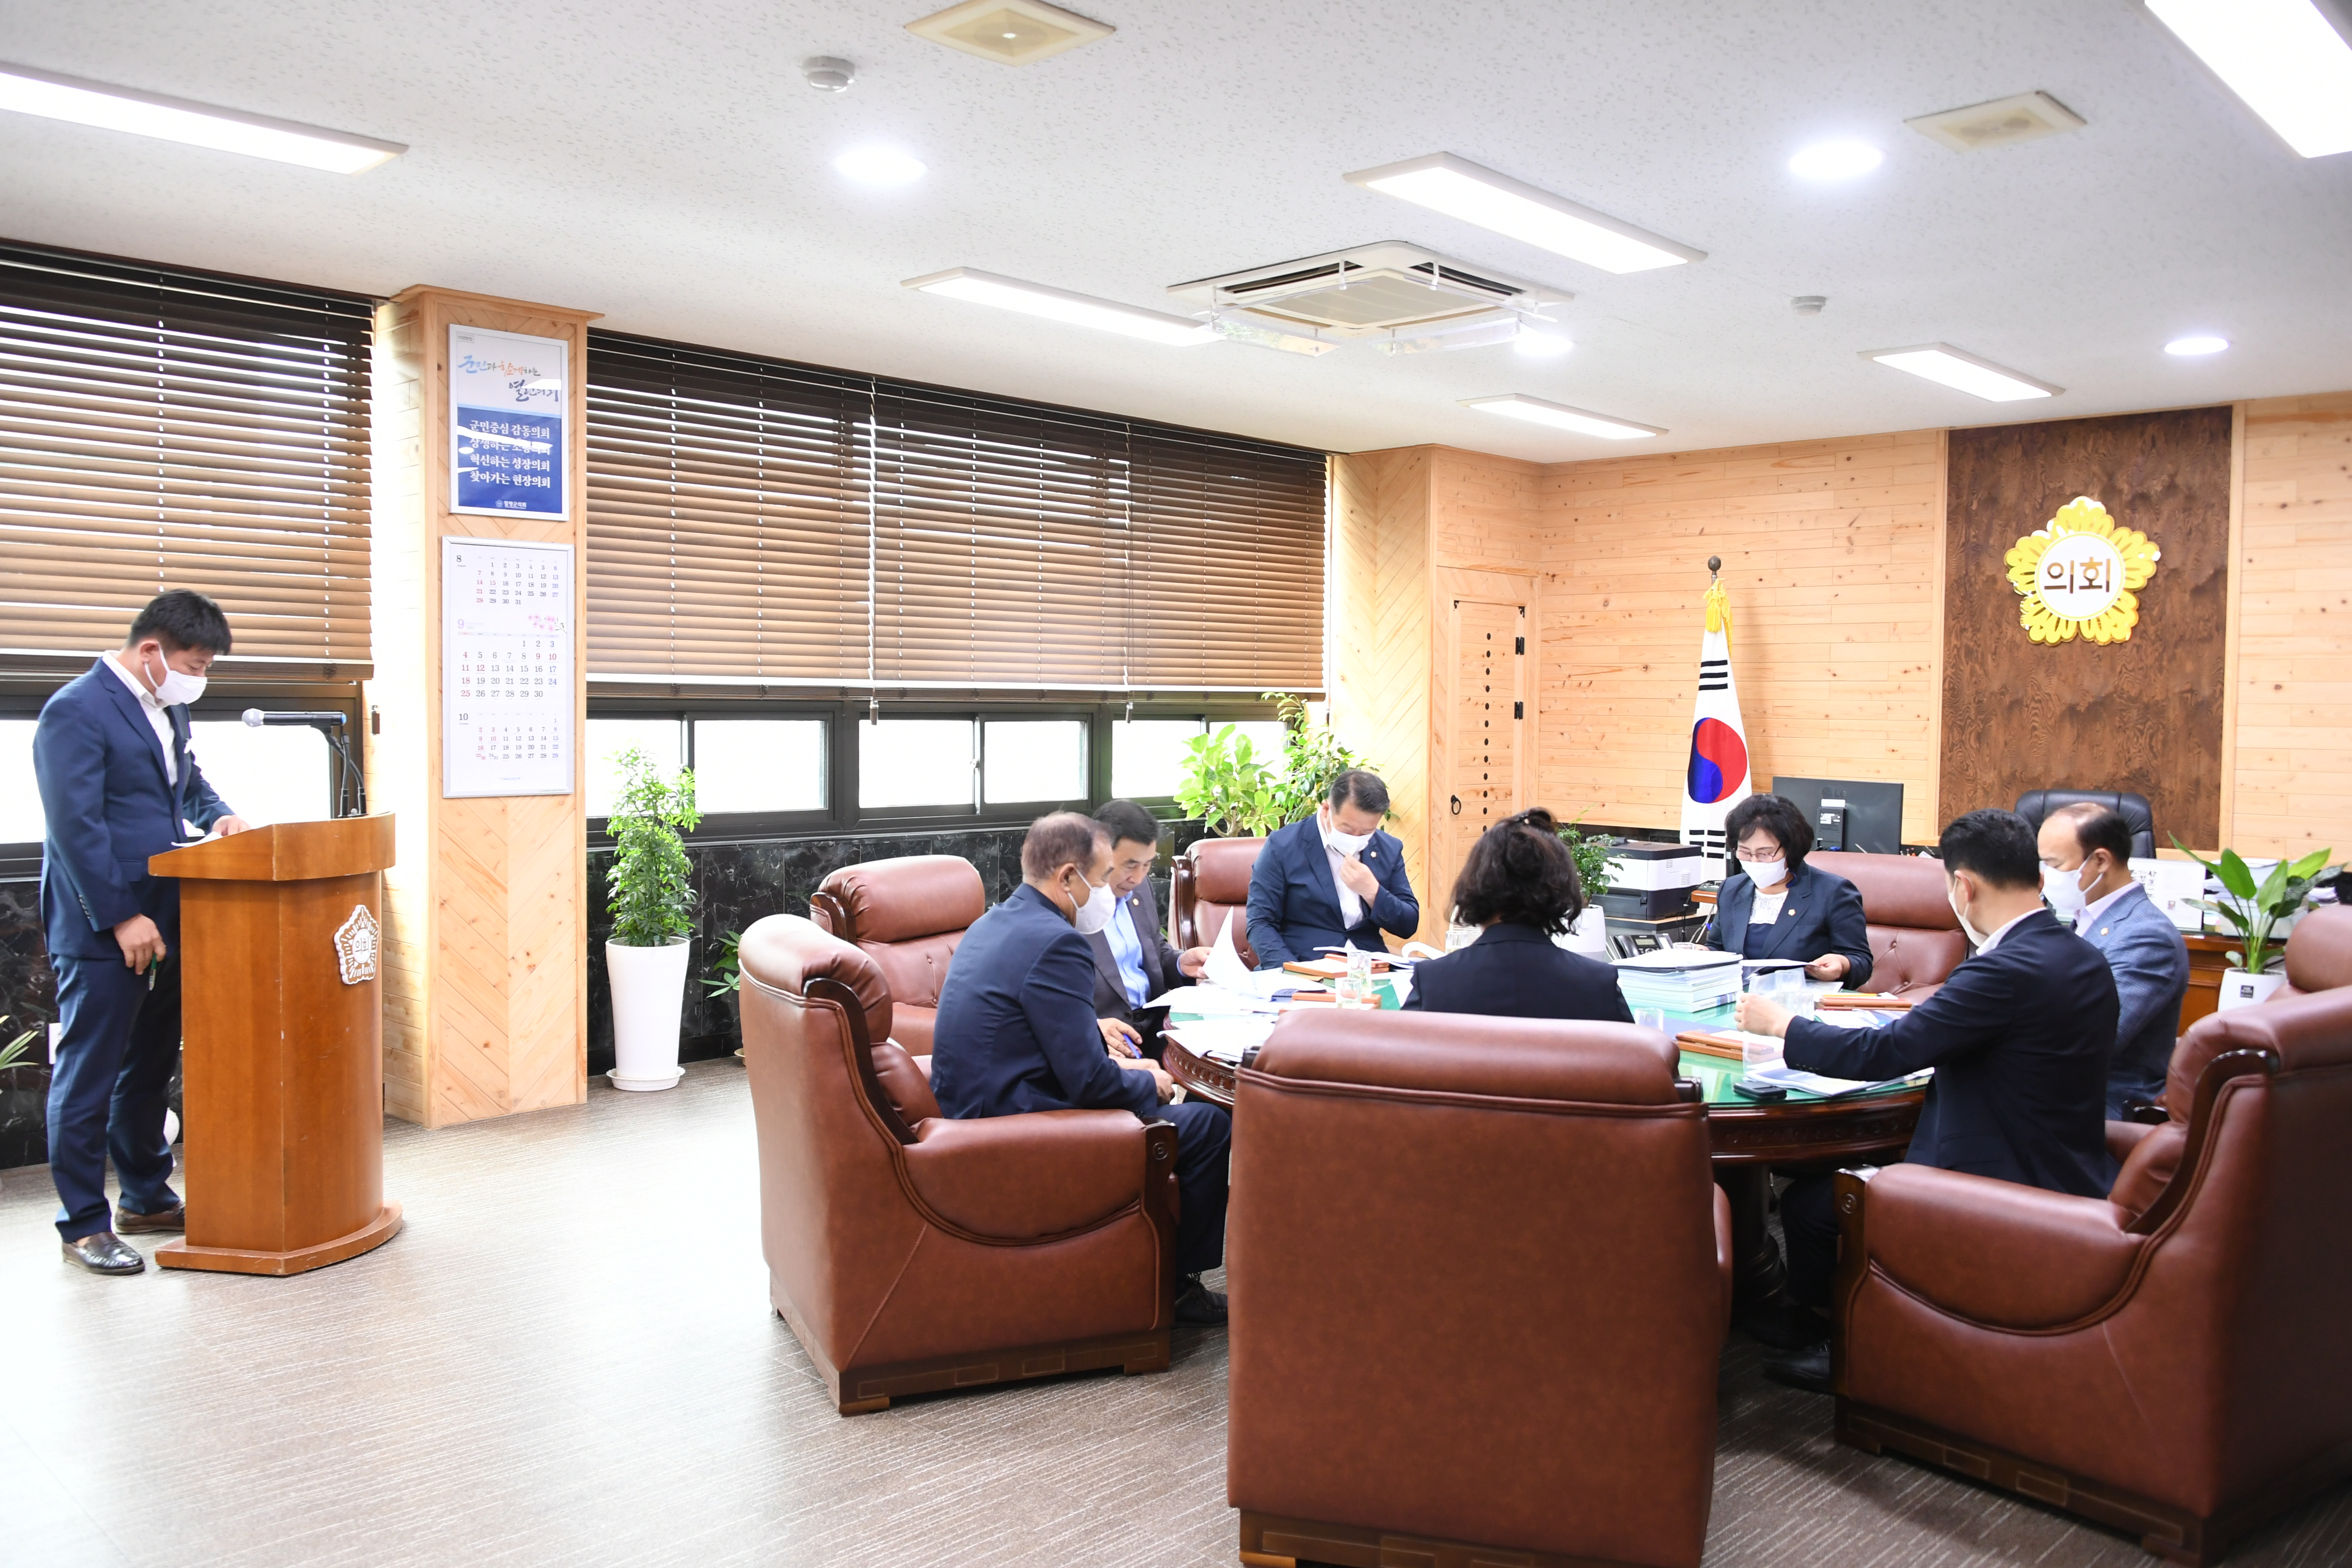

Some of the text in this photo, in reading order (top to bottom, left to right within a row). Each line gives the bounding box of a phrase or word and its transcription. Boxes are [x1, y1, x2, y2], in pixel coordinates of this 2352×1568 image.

[457, 355, 541, 377] 군민과 함께하는
[469, 420, 550, 438] 군민중심 감동의회
[470, 453, 550, 472] 혁신하는 성장의회
[470, 471, 550, 488] 찾아가는 현장의회
[2044, 556, 2111, 594] 의회
[457, 619, 464, 629] 9
[355, 936, 370, 955] 의회
